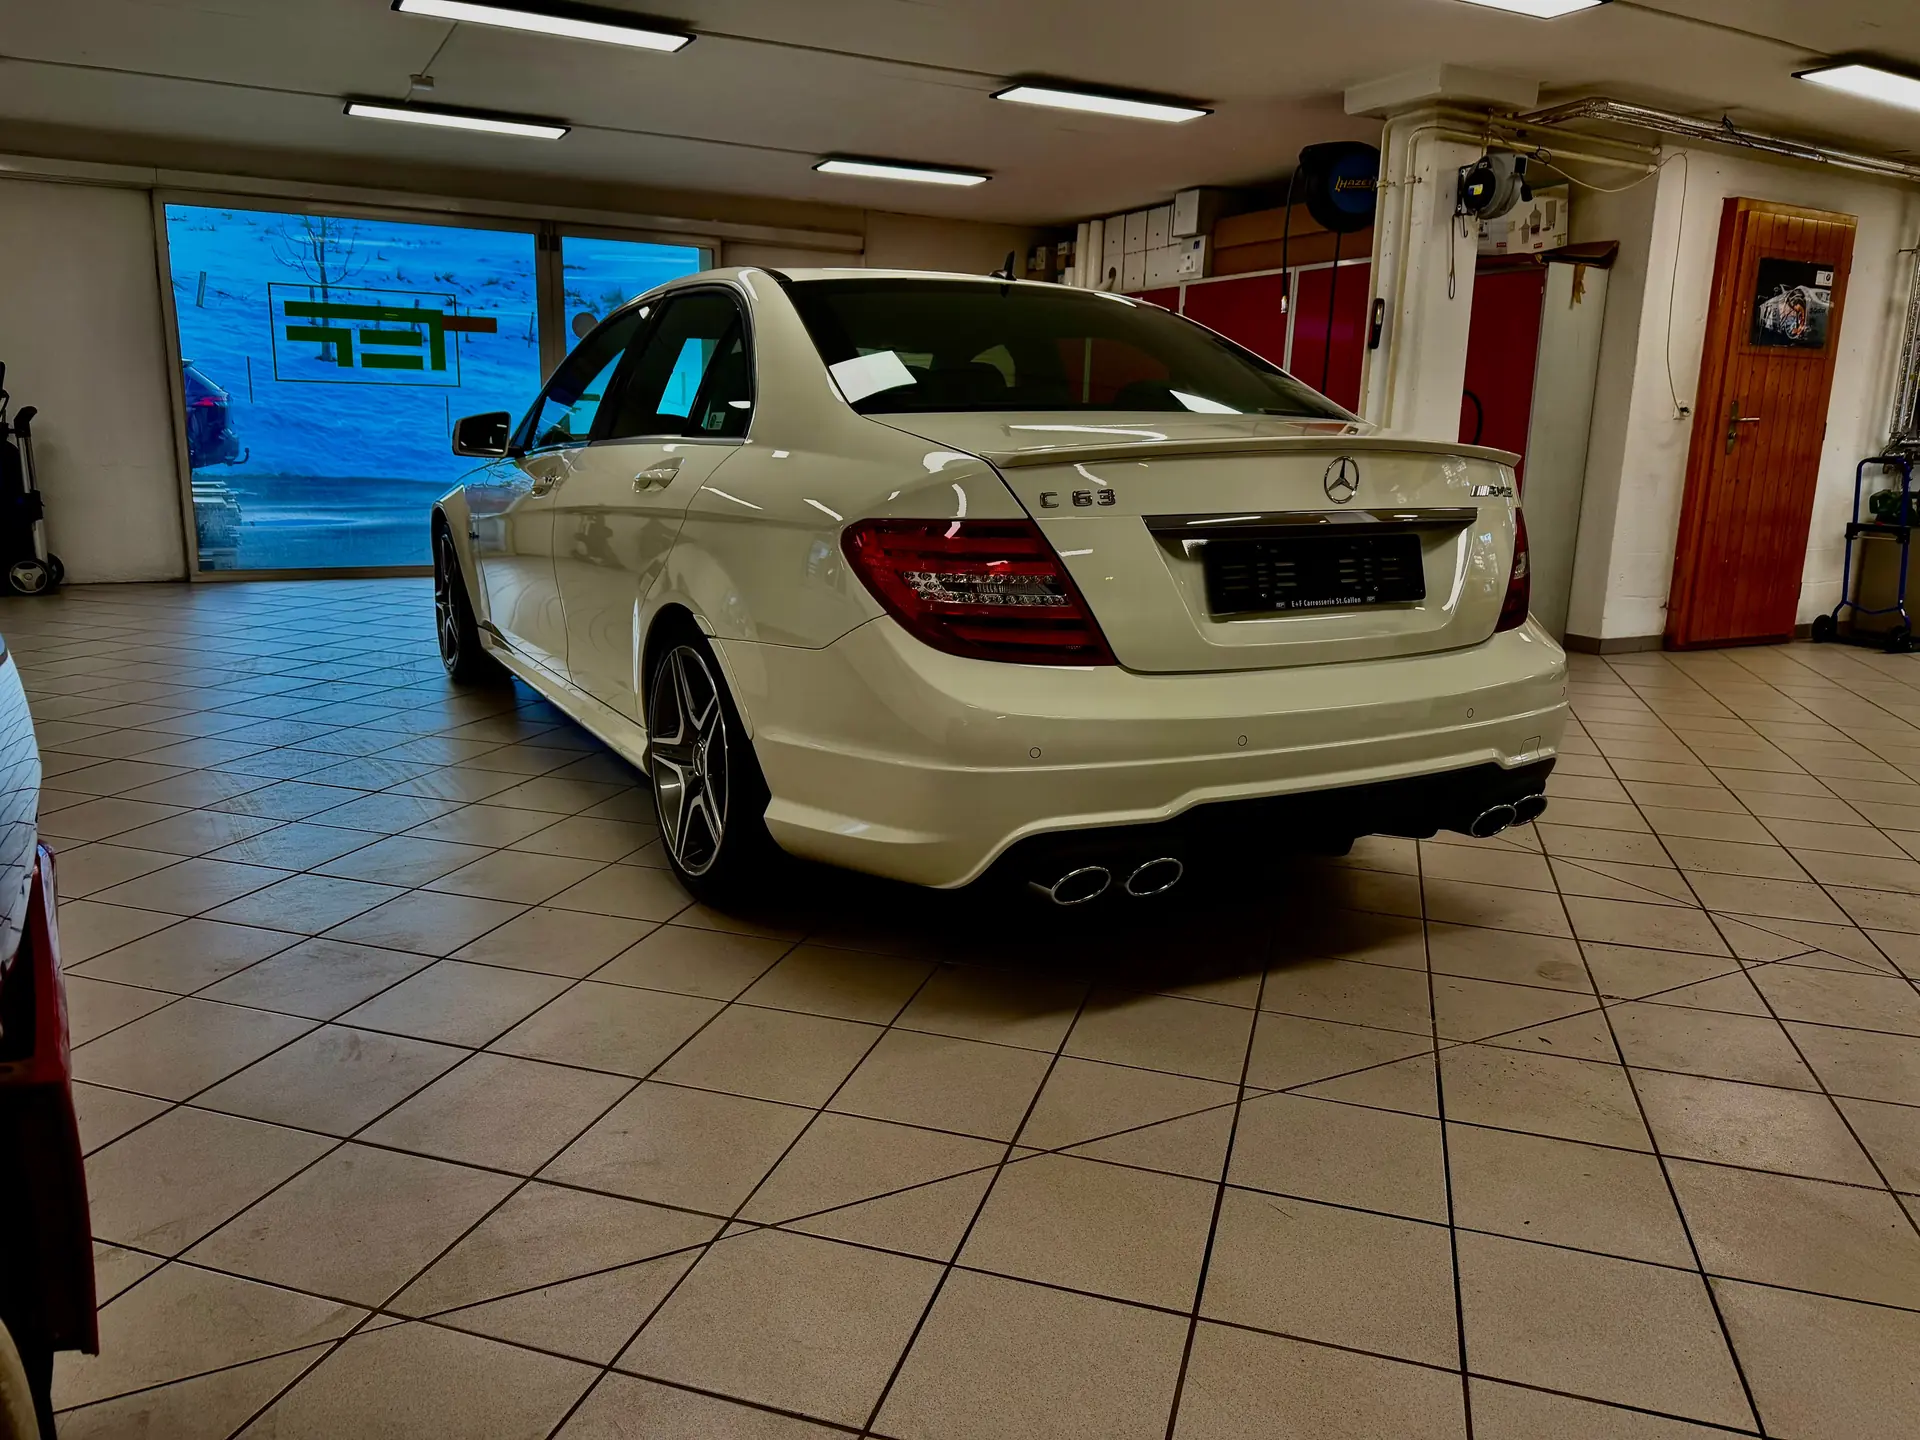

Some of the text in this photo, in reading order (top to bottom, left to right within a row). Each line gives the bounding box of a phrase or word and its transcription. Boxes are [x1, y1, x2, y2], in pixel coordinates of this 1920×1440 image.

[1039, 488, 1116, 509] C 63
[1303, 596, 1335, 608] Carrosserie
